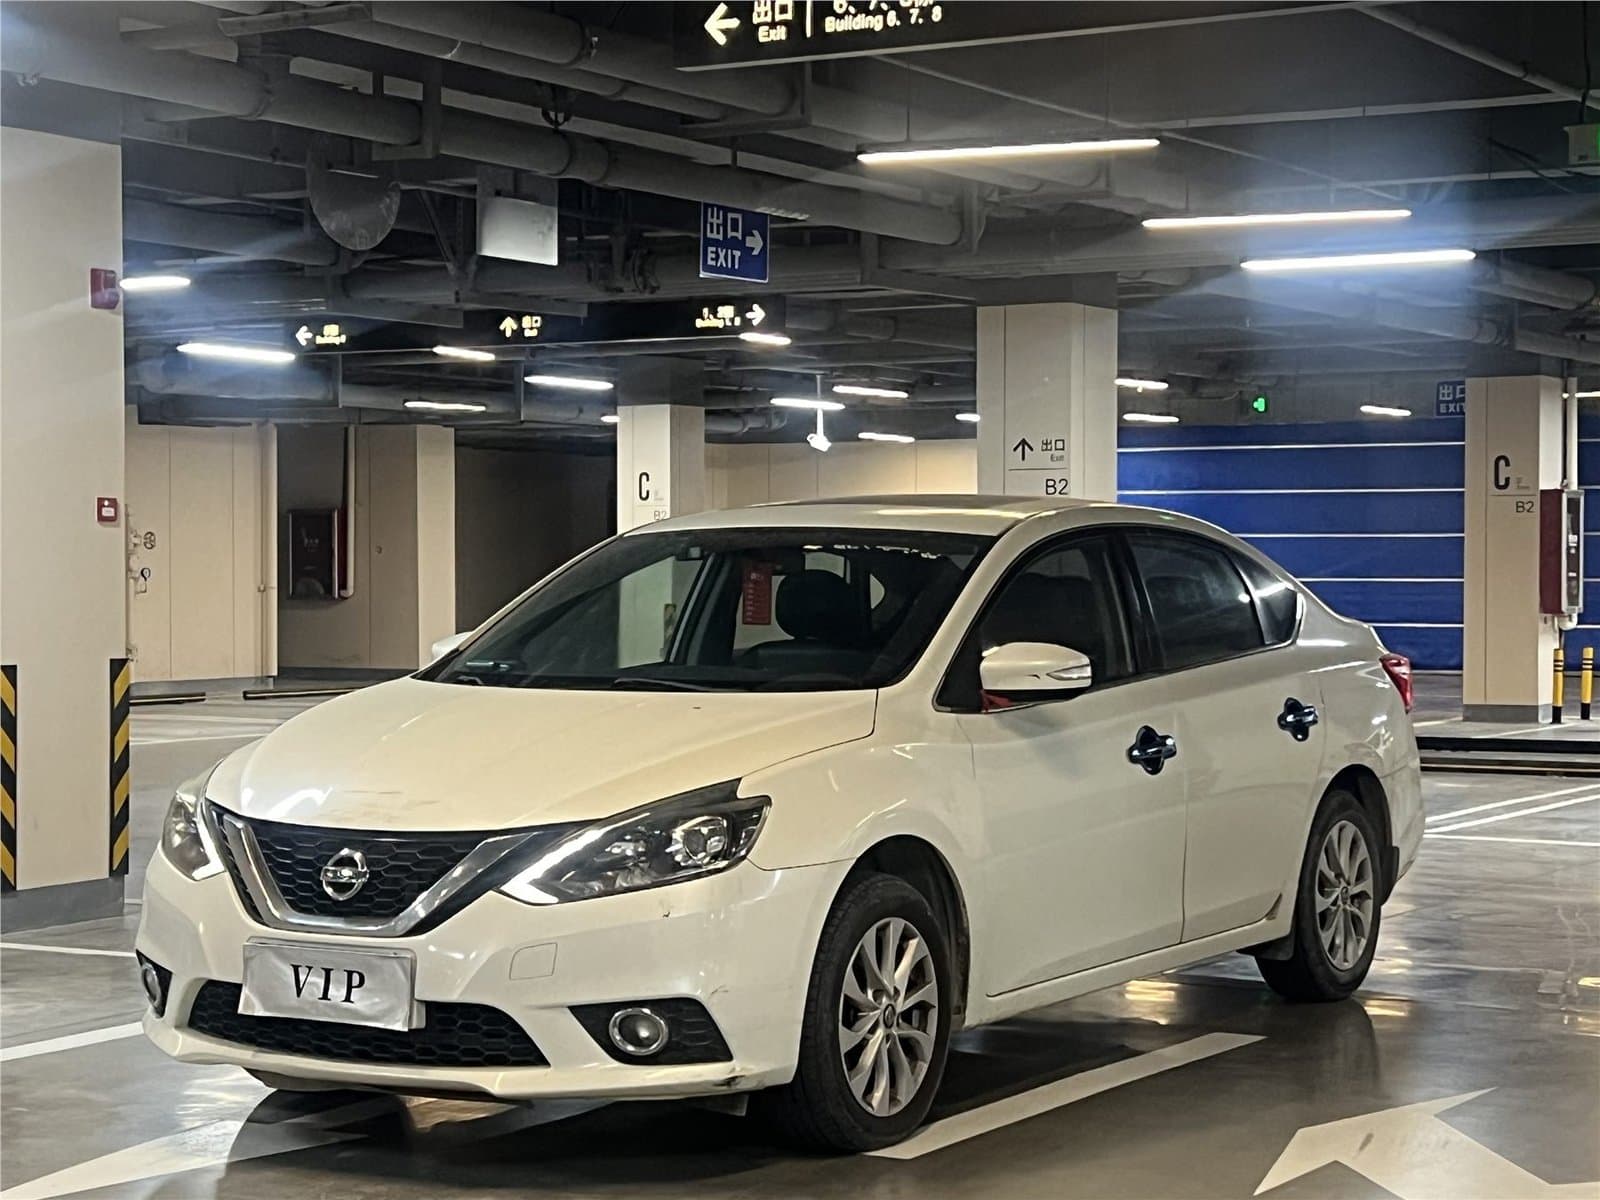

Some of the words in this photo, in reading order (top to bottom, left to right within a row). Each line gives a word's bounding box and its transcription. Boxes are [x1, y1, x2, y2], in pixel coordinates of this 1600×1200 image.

[752, 0, 793, 24] 出口
[758, 25, 787, 43] Exit
[825, 14, 884, 33] Building
[706, 206, 743, 241] 出口
[706, 246, 742, 270] EXIT
[1439, 384, 1465, 400] 出口
[1041, 438, 1065, 452] 出口
[1494, 455, 1510, 491] C
[639, 472, 650, 501] C
[1045, 478, 1068, 496] B2
[1515, 501, 1535, 513] B2
[290, 964, 365, 1003] VIP
